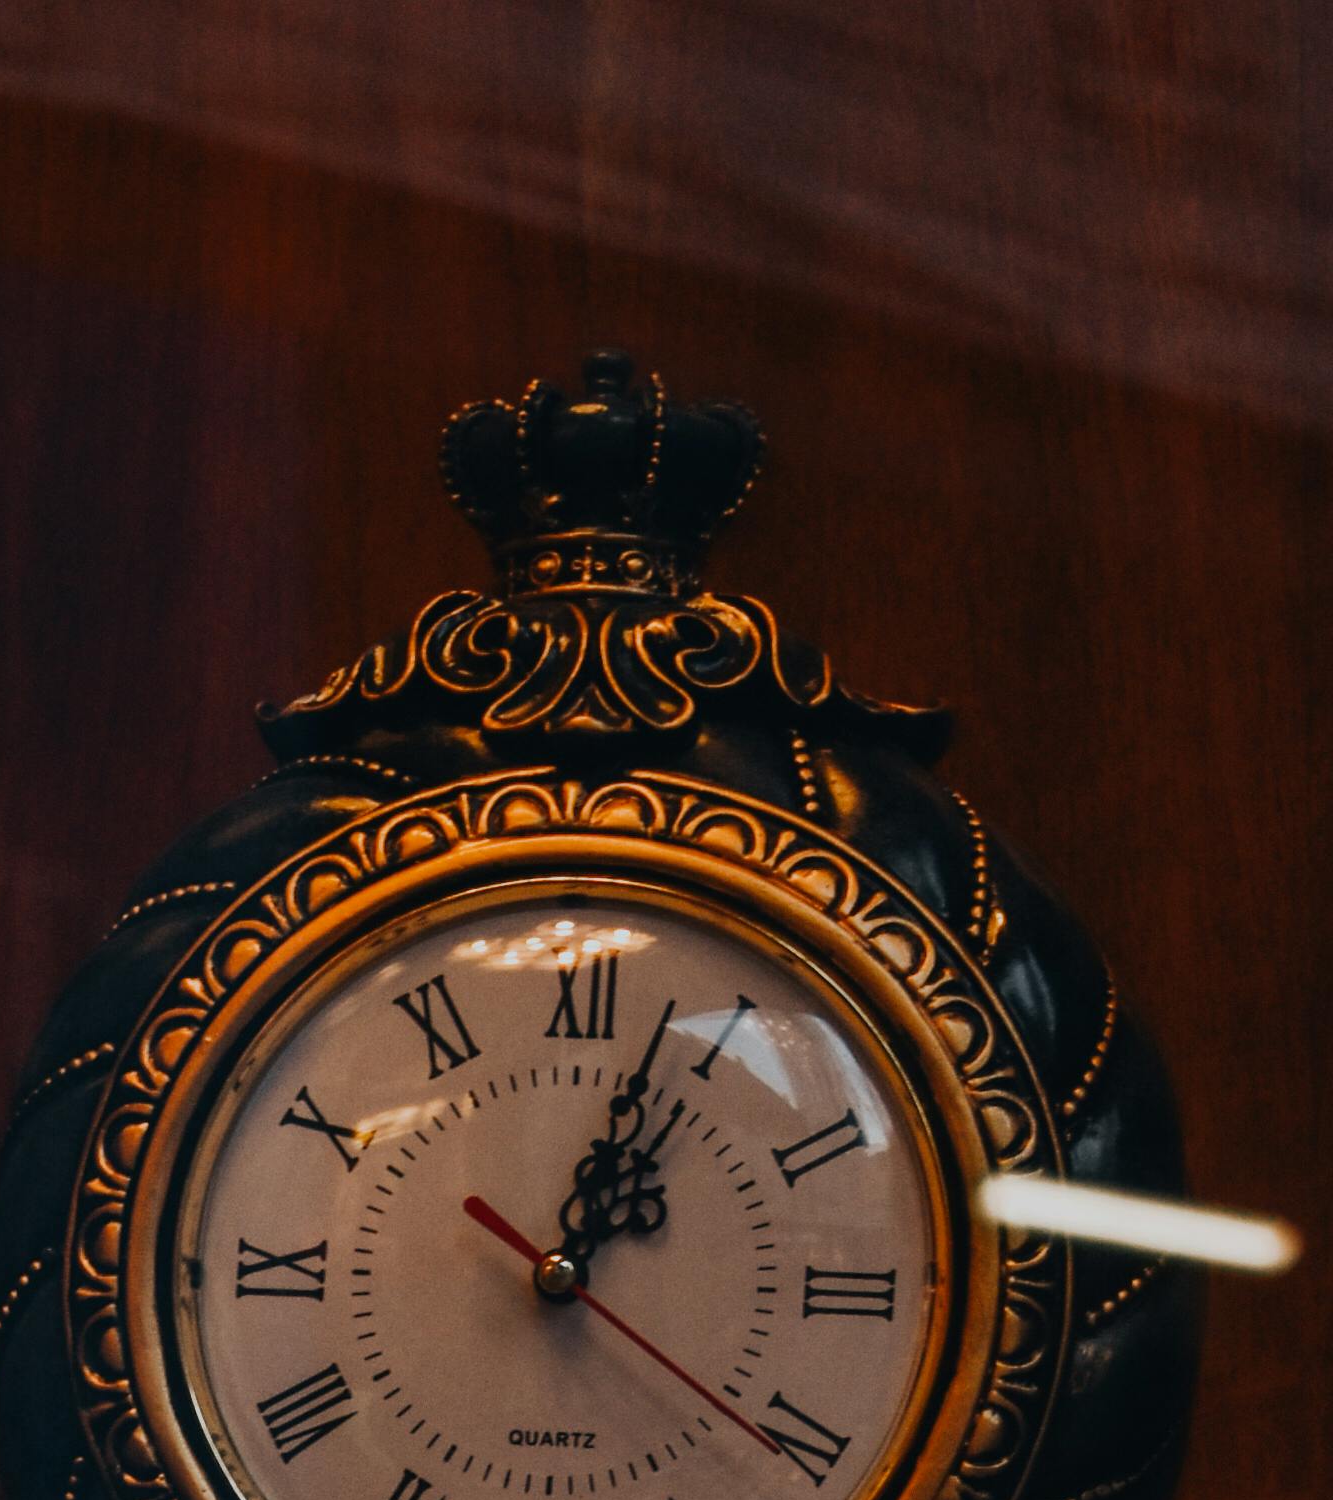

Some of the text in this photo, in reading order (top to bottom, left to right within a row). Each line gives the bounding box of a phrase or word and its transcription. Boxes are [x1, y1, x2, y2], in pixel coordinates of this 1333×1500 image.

[392, 973, 482, 1080] XI
[545, 946, 620, 1039] XII
[690, 994, 757, 1080] I
[279, 1085, 374, 1172] X
[771, 1108, 865, 1189] II
[235, 1238, 328, 1302] IX
[802, 1265, 897, 1322] III
[256, 1362, 356, 1465] VIII
[508, 1428, 596, 1449] QUARTZ
[756, 1390, 852, 1488] IV
